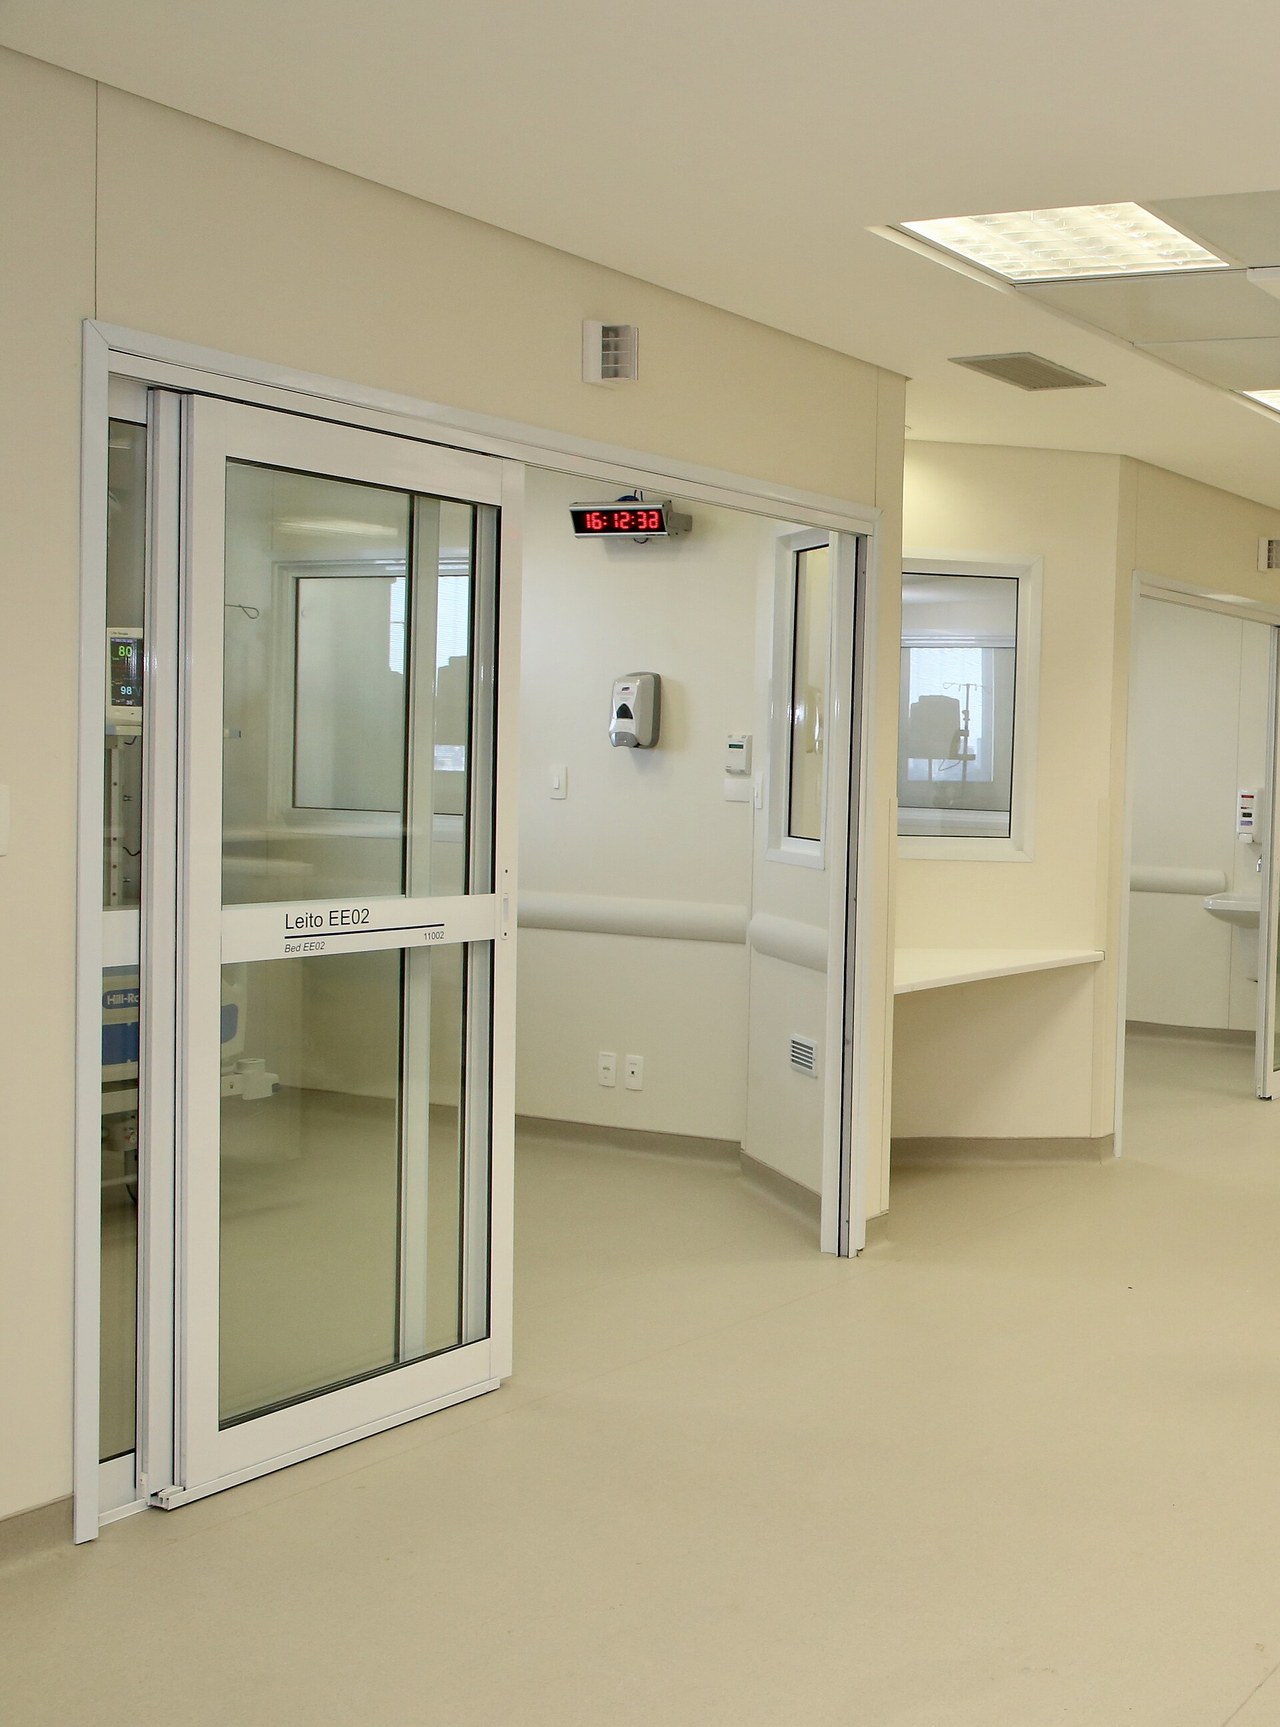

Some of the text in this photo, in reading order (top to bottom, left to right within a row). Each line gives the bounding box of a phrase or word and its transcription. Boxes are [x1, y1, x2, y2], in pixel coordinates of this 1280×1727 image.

[118, 645, 133, 657] 80
[120, 686, 133, 695] 98
[285, 908, 370, 930] Leito EE02
[424, 931, 445, 941] 11002
[284, 941, 326, 953] Bed EE02
